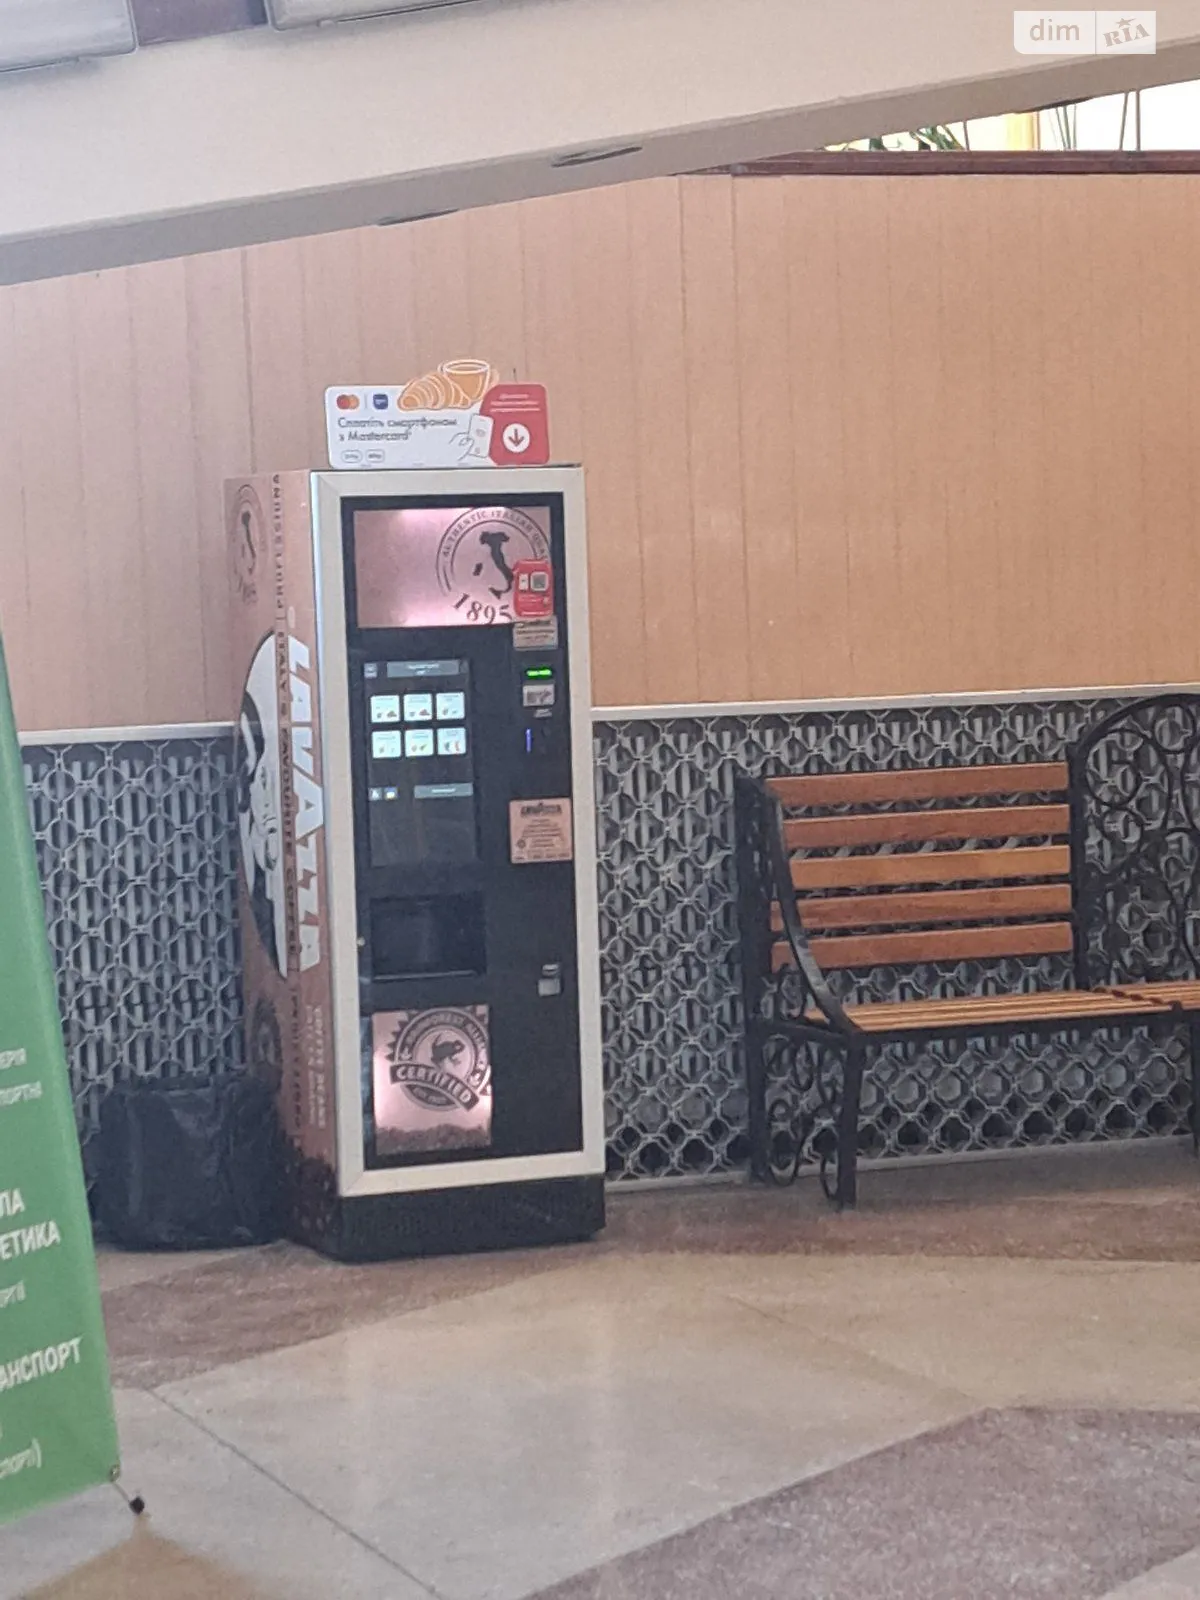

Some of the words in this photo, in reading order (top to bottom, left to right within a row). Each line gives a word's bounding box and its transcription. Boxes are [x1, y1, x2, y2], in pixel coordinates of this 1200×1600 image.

[453, 592, 513, 624] 1895
[288, 634, 323, 972] LAVAZZA
[396, 1065, 471, 1103] CERTIFIED
